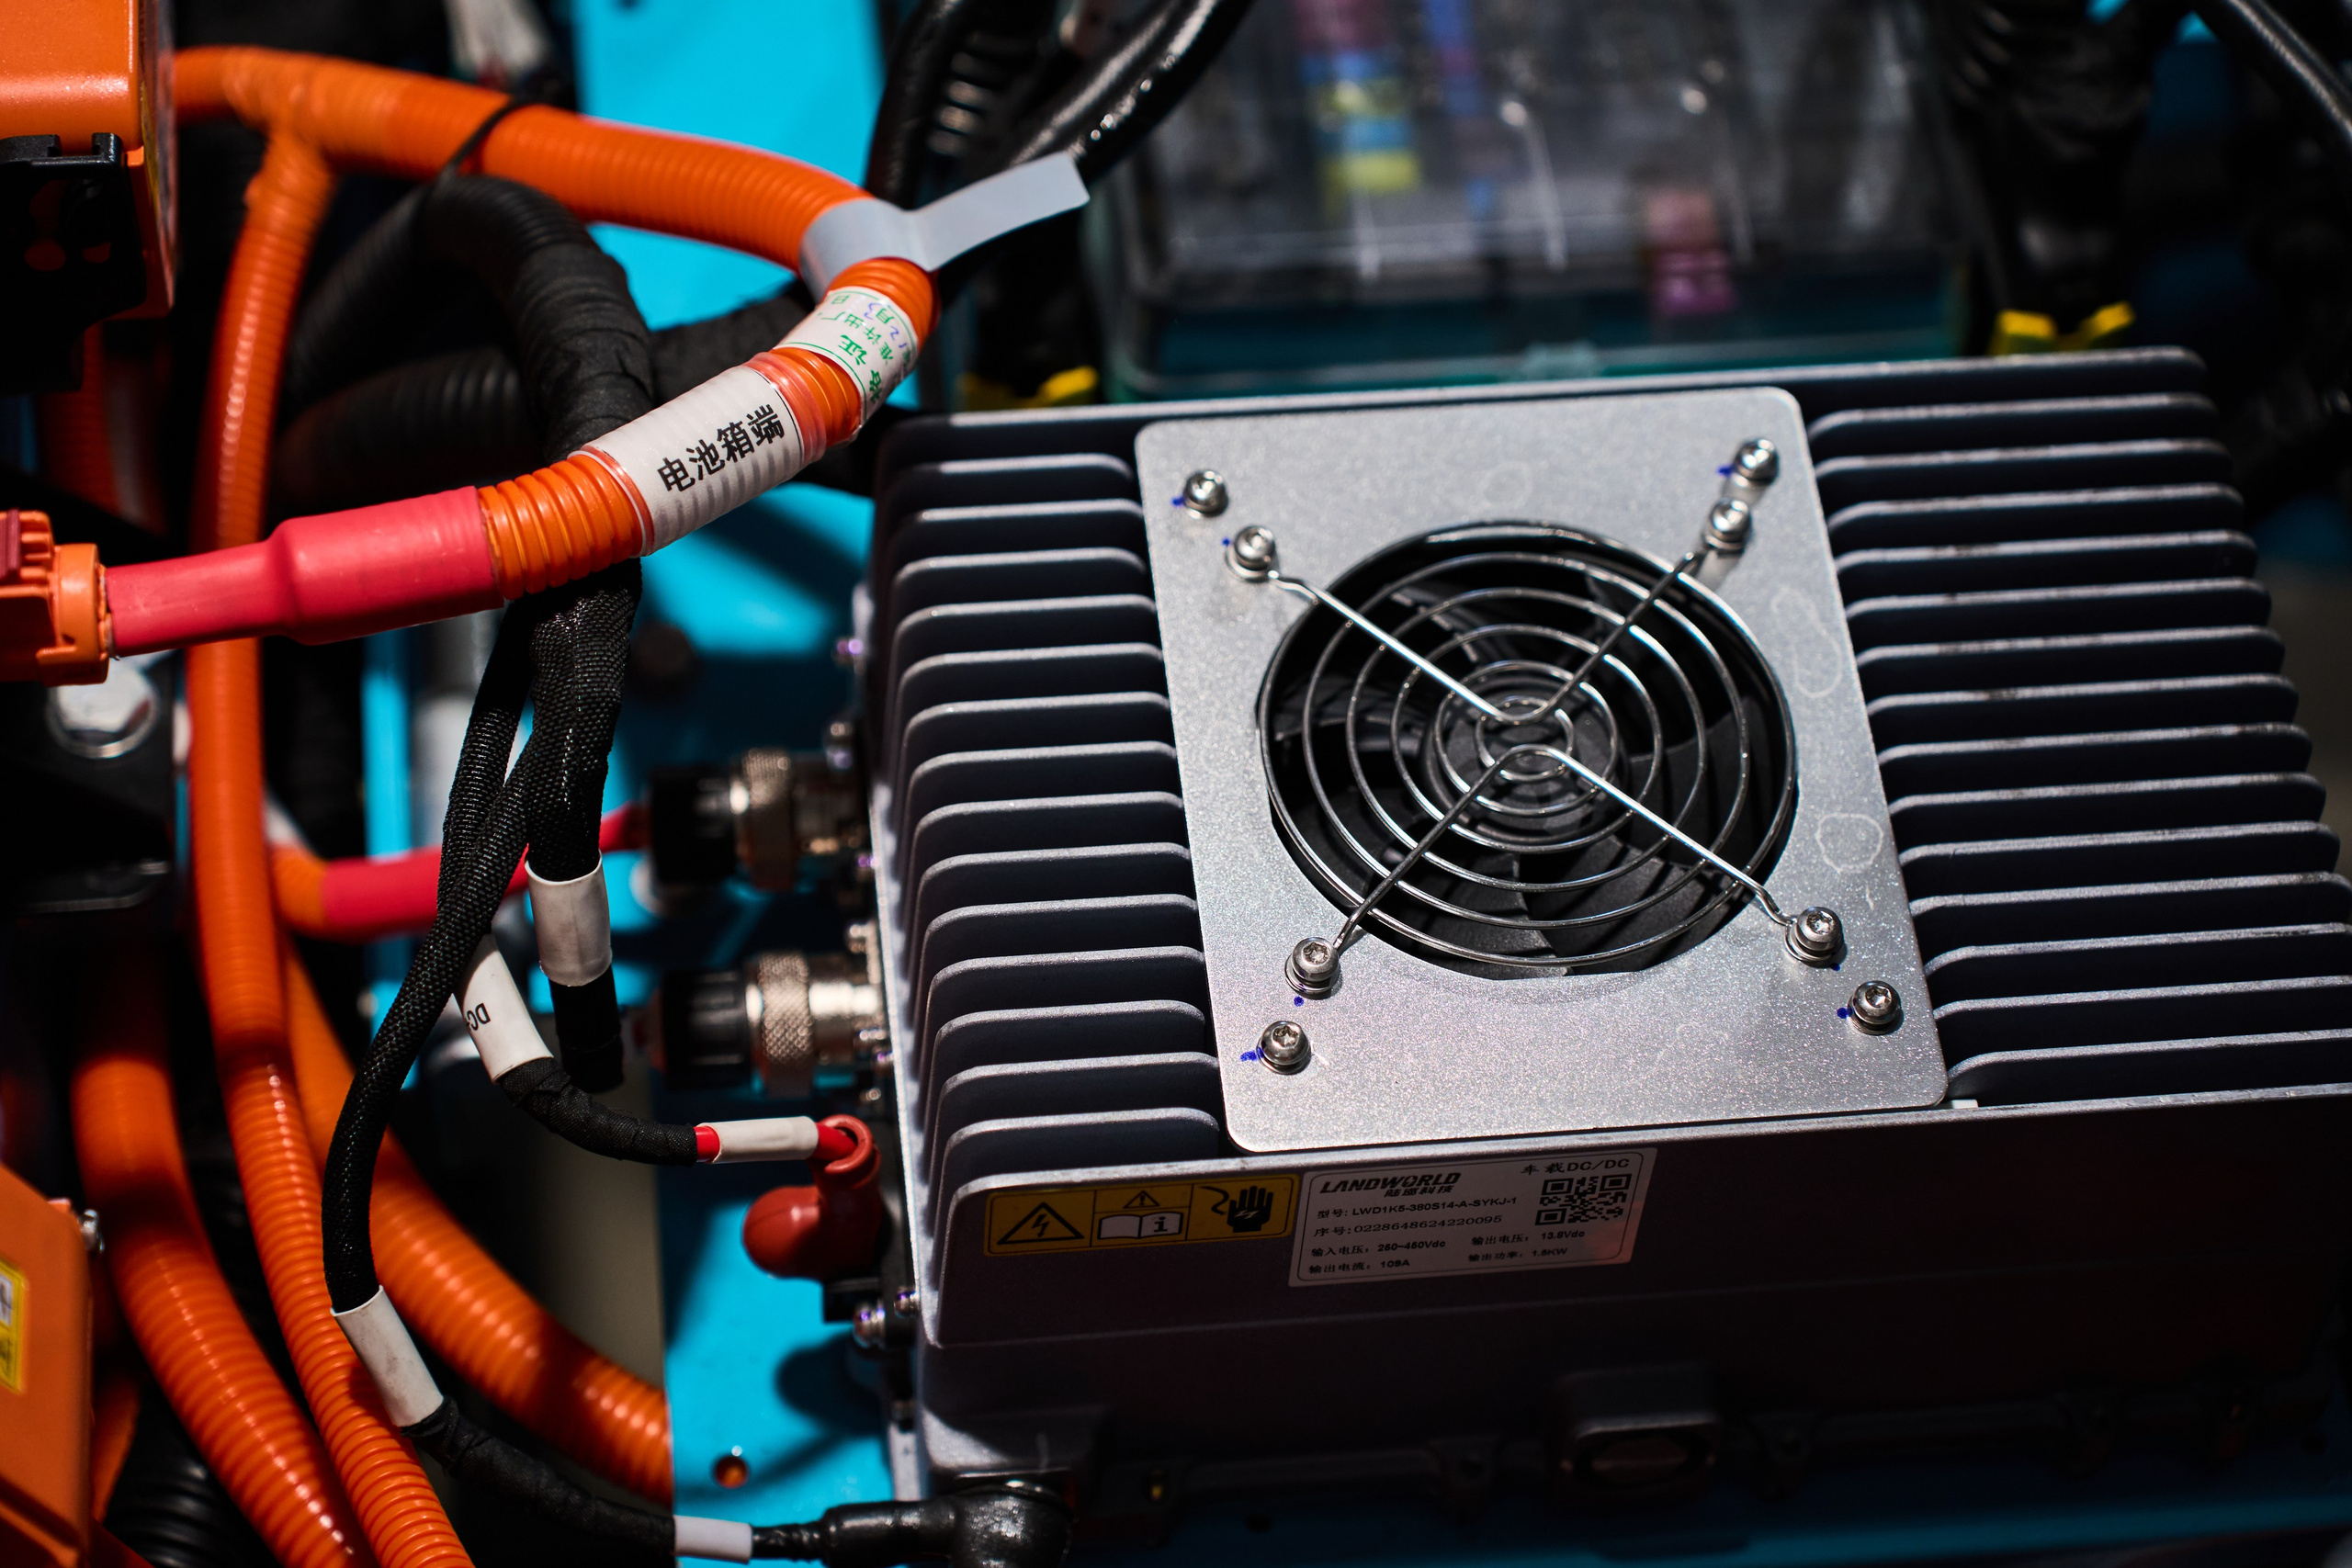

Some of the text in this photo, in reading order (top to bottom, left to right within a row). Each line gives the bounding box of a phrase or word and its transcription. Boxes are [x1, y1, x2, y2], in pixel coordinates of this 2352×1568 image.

[657, 404, 786, 491] 电池箱端
[1319, 1172, 1462, 1193] LANDWORLD
